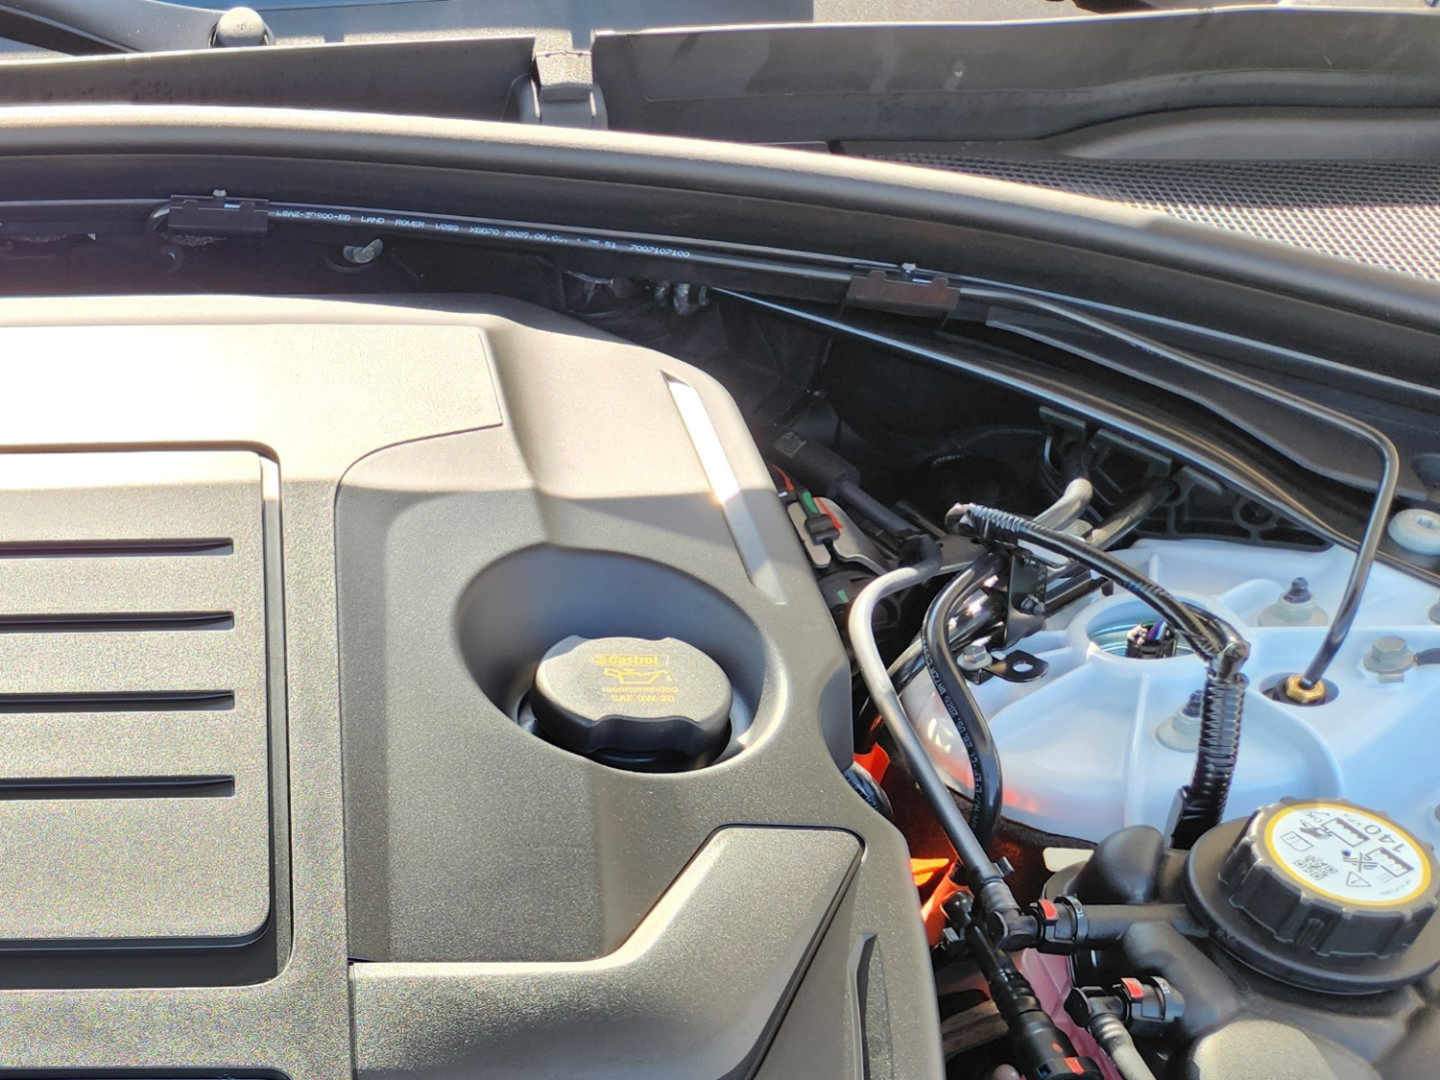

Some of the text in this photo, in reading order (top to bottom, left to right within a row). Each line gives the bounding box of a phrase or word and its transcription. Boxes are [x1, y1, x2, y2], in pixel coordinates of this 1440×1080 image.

[360, 215, 385, 225] LAND
[394, 218, 425, 229] ROVER
[608, 655, 659, 666] Castrol
[1305, 811, 1323, 824] OK
[1363, 824, 1405, 853] 140
